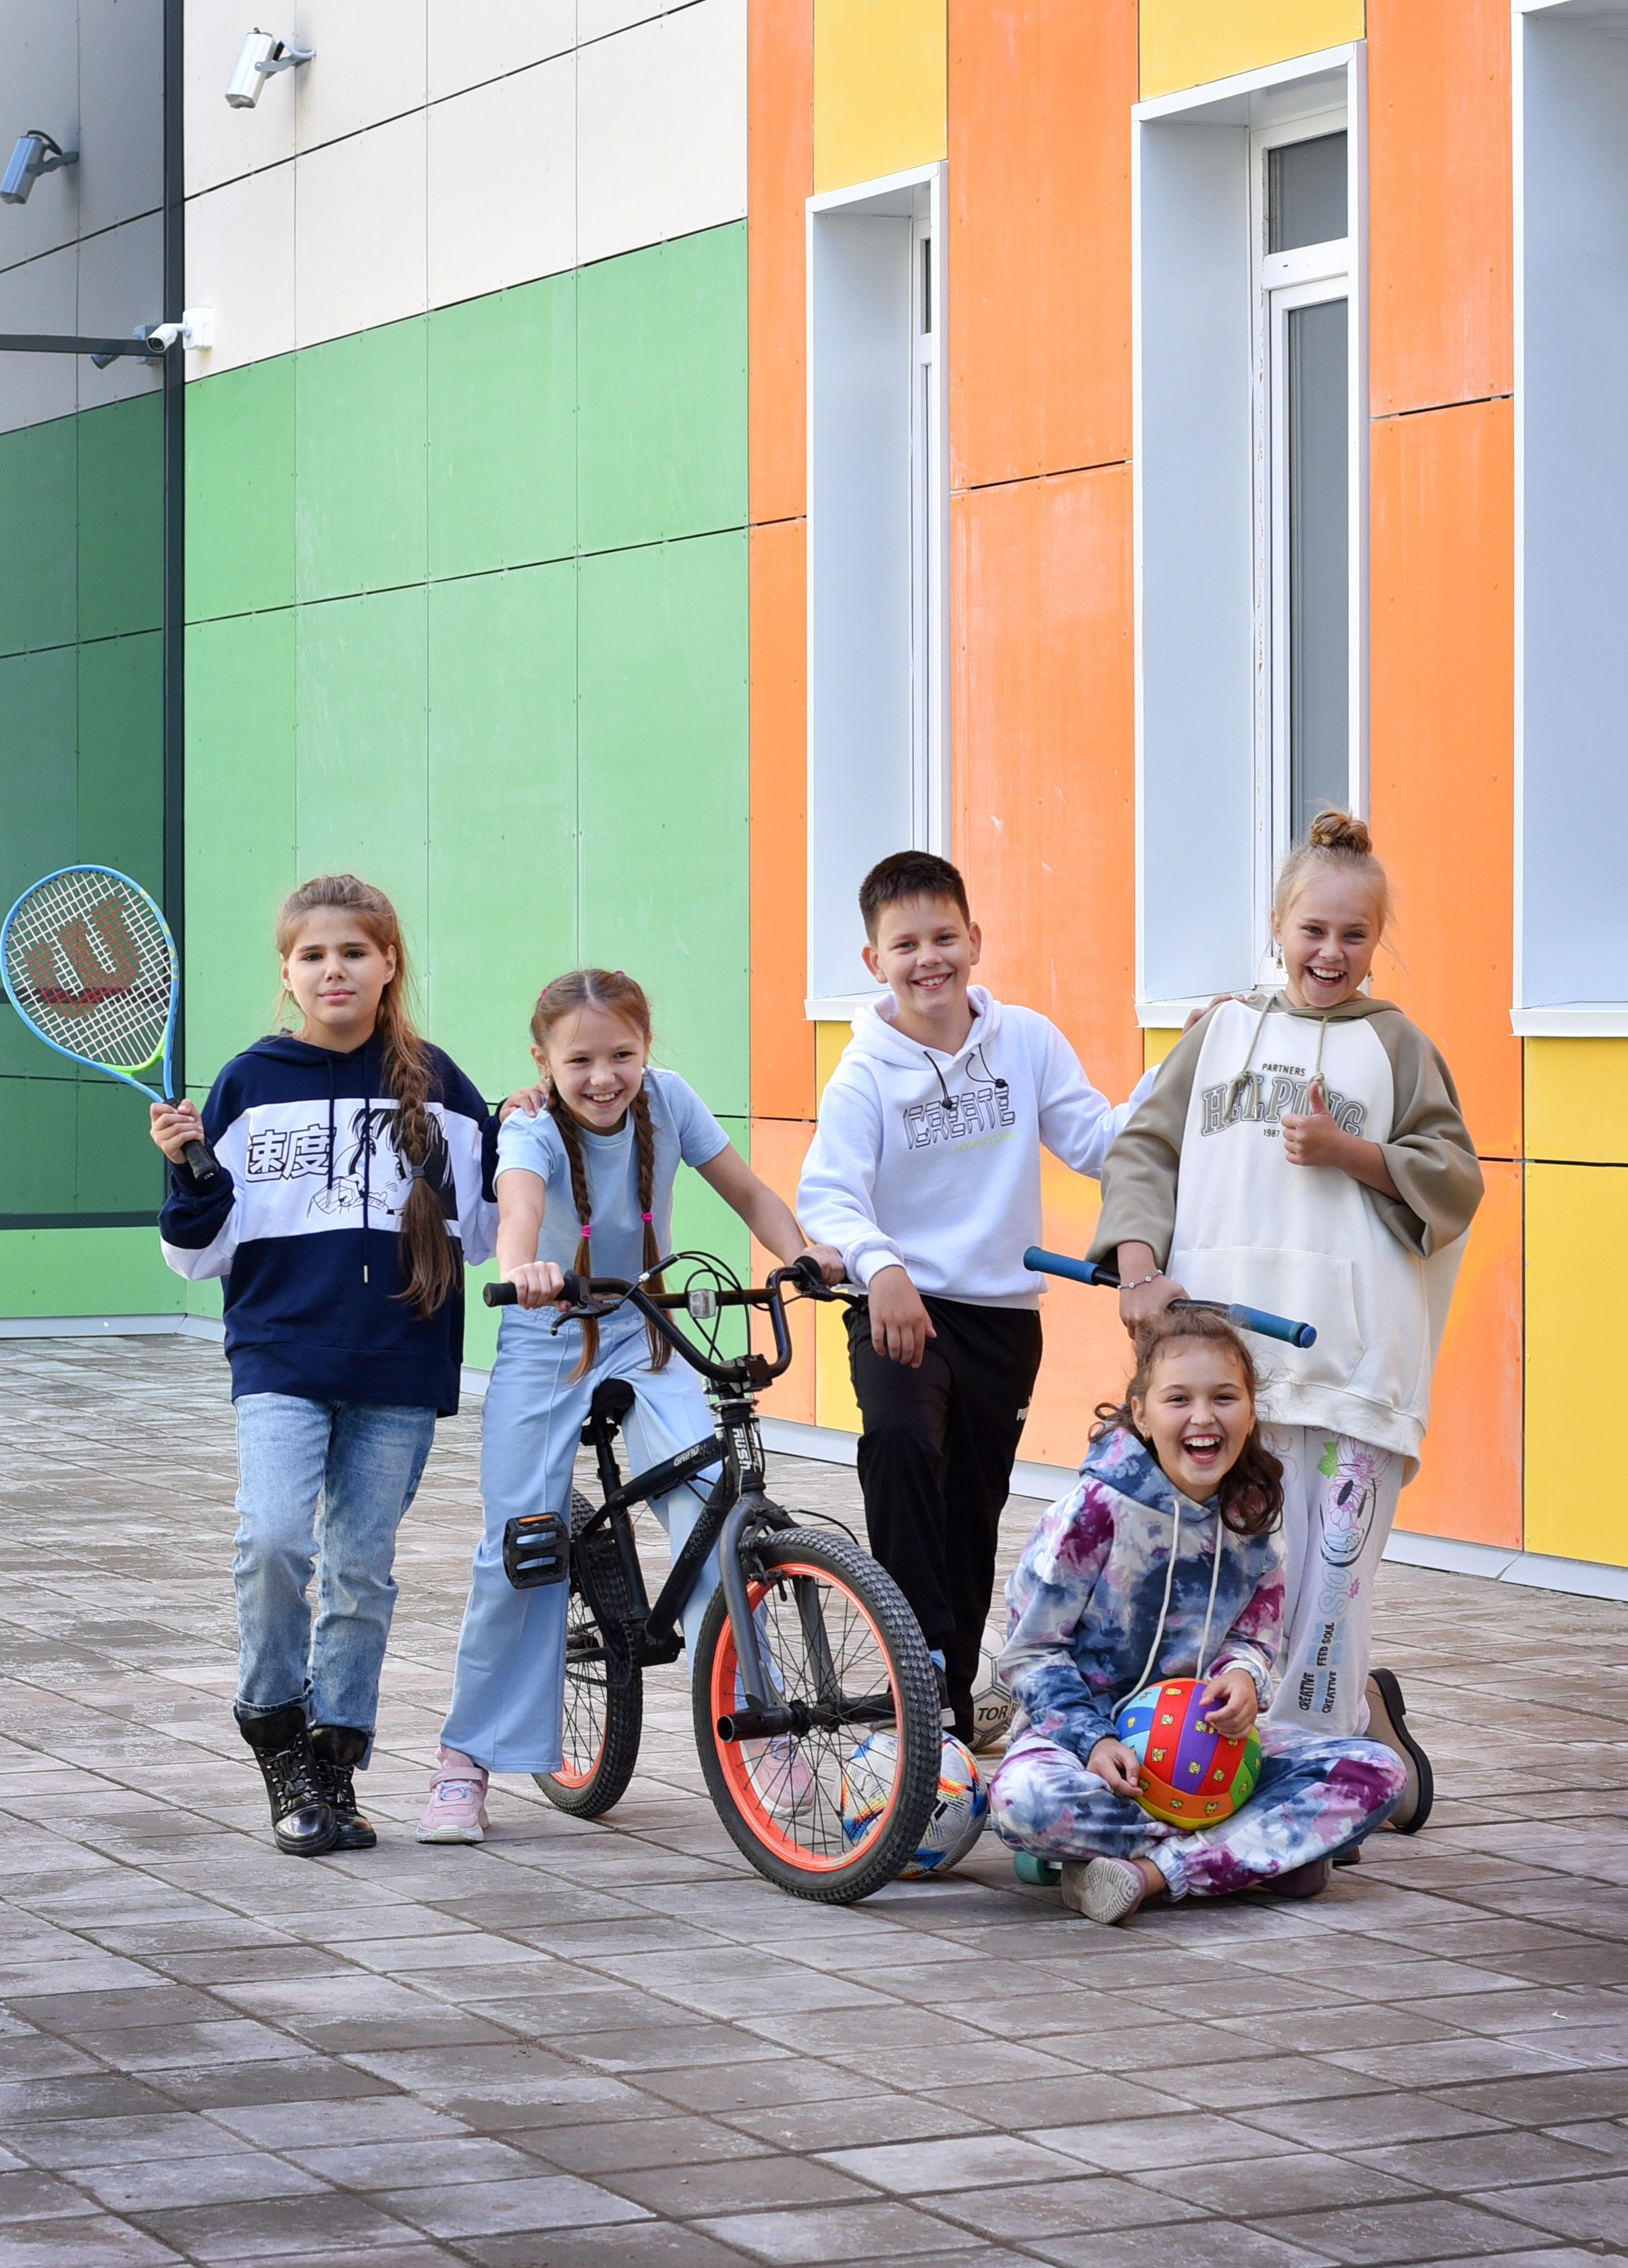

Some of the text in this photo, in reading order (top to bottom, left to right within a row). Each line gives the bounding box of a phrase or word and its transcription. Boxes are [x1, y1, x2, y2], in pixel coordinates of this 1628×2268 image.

[1261, 1062, 1306, 1077] PARTNERS
[1263, 1129, 1280, 1138] 1987
[245, 1123, 337, 1183] 速度
[1321, 1621, 1335, 1644] SOUL
[1316, 1646, 1329, 1667] FEED
[1298, 1671, 1315, 1711] CREATIVE
[1322, 1670, 1337, 1714] CREATIVE
[977, 1702, 1021, 1722] TORR
